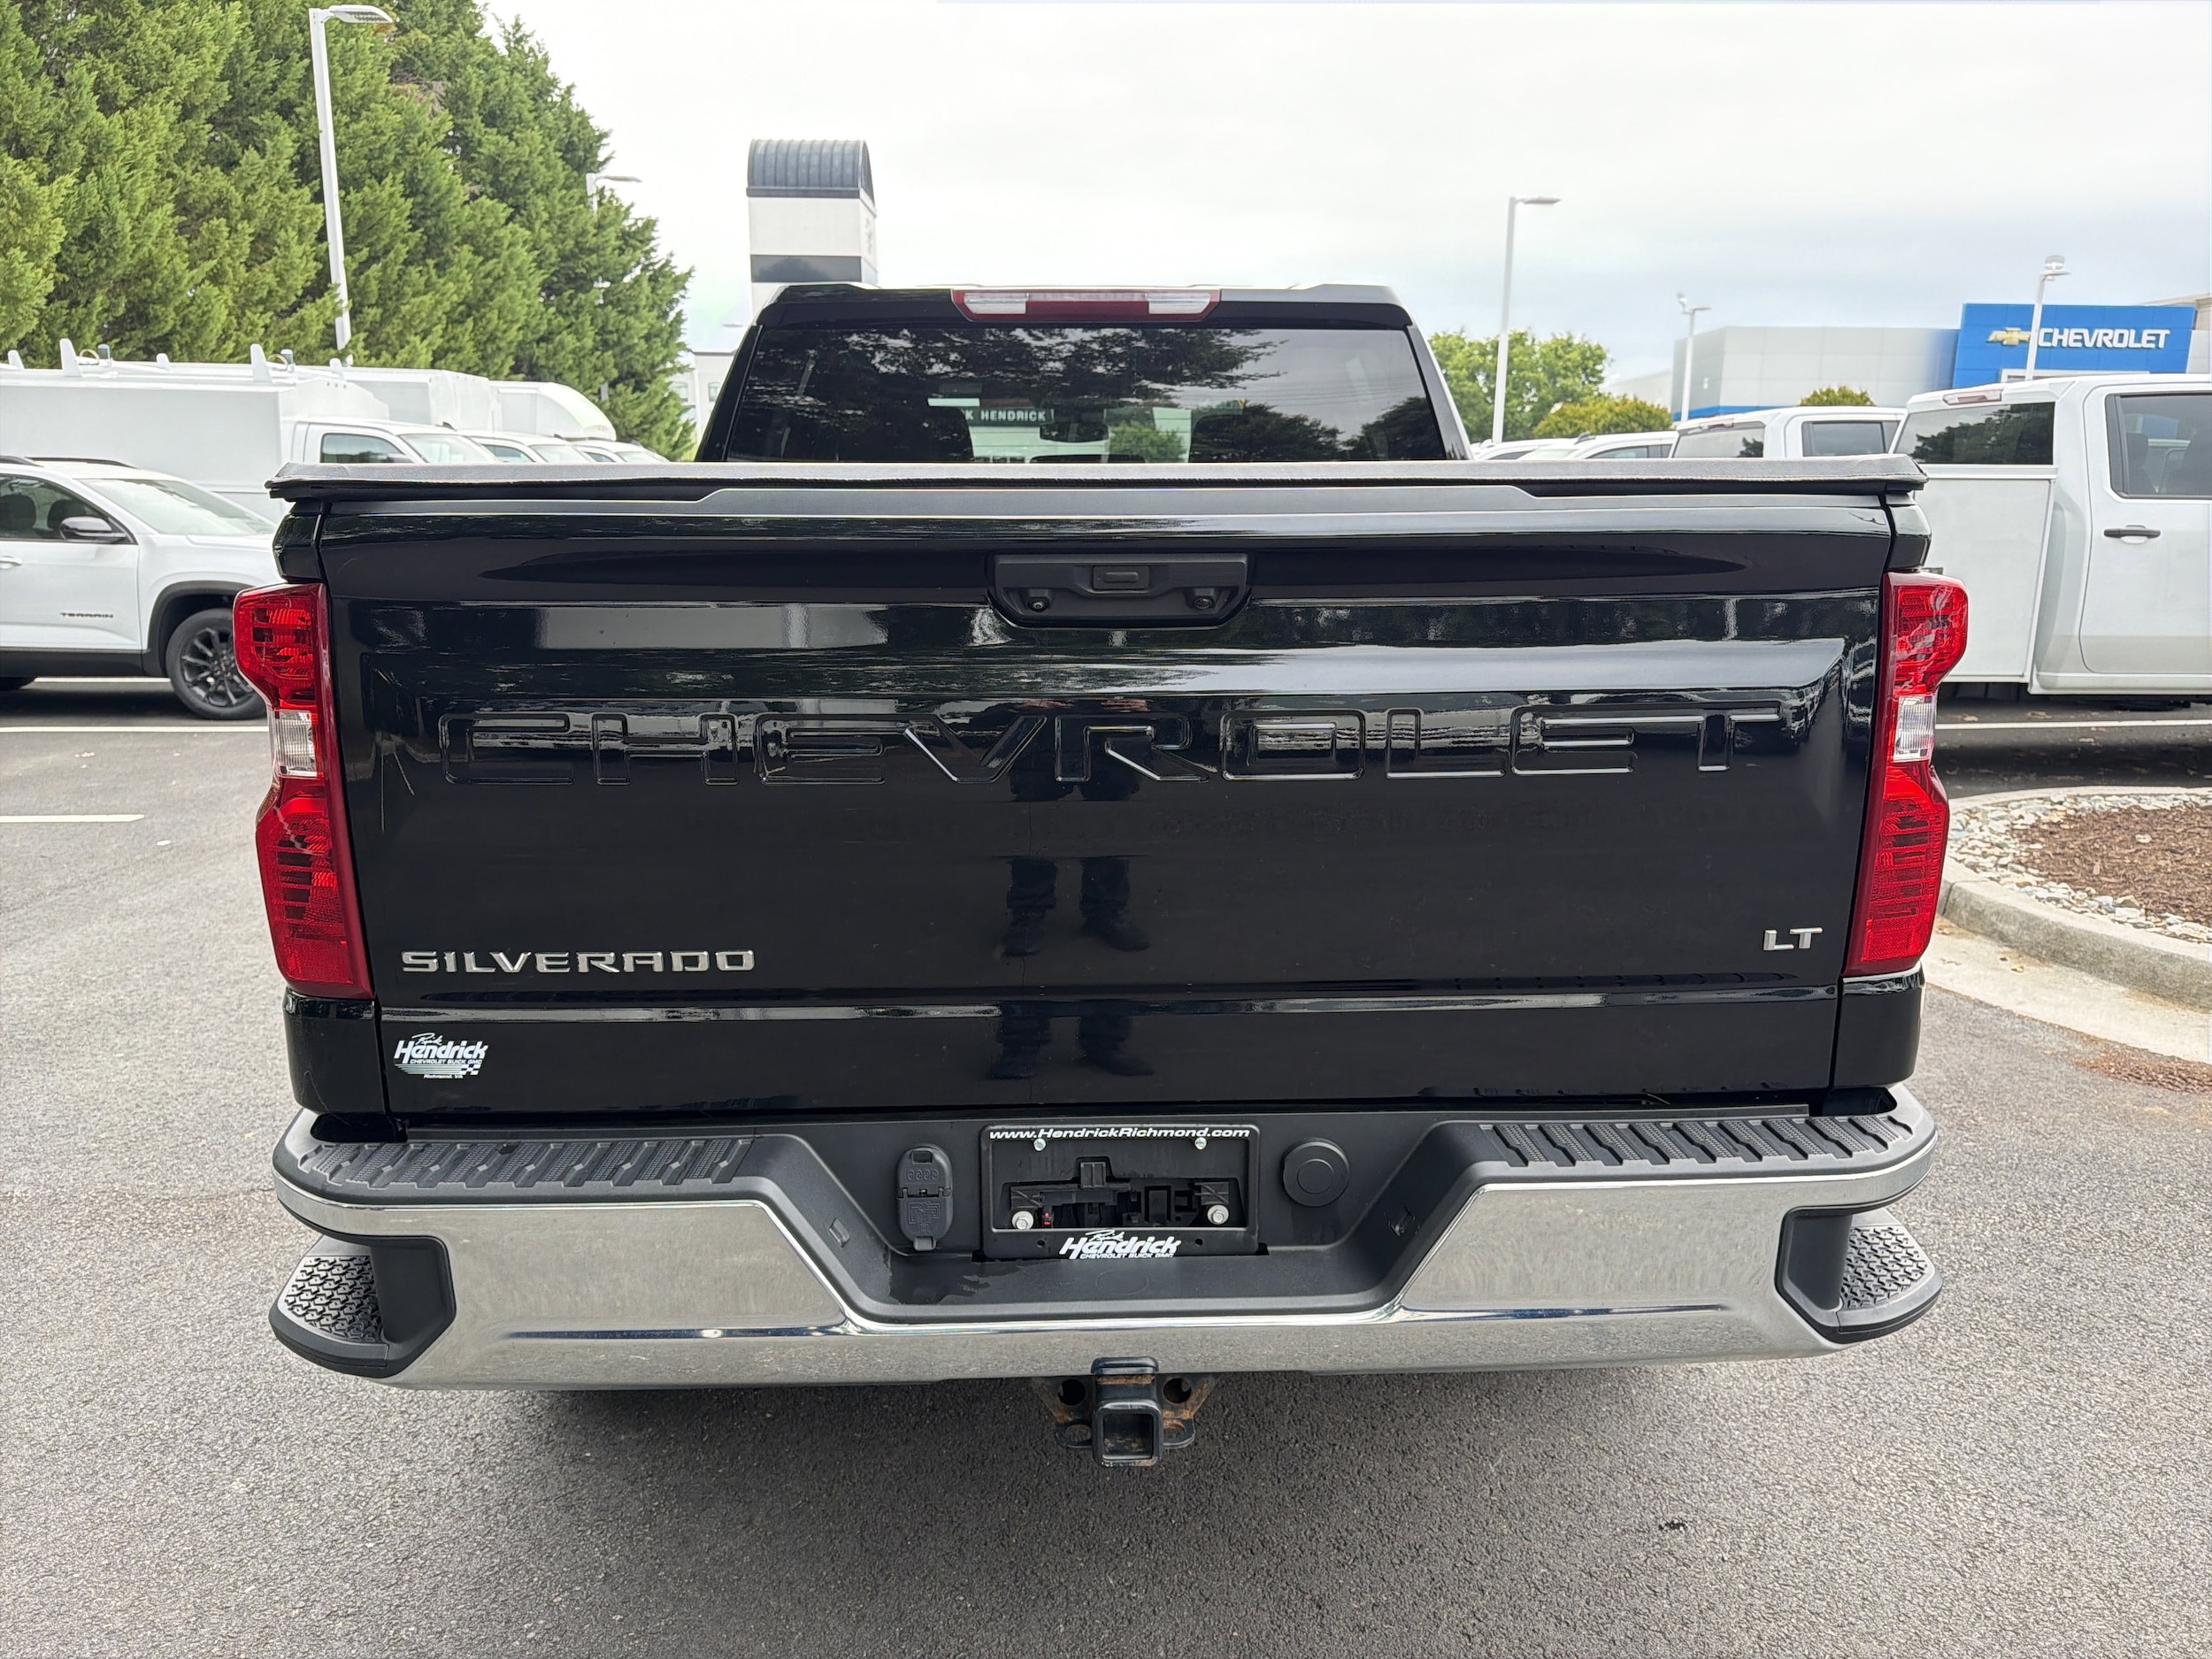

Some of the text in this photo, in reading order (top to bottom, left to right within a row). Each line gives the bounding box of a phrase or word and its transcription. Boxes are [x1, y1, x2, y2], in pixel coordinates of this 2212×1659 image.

[2038, 327, 2170, 349] CHEVROLET
[980, 410, 1046, 421] HENDRICK
[439, 700, 1782, 786] CHEVROLET
[1763, 927, 1823, 951] LT
[401, 949, 755, 972] SILVERADO
[394, 1041, 488, 1064] Hendrick
[990, 1127, 1250, 1140] www.HendrickRichmond.com
[1059, 1236, 1182, 1259] Hendrick
